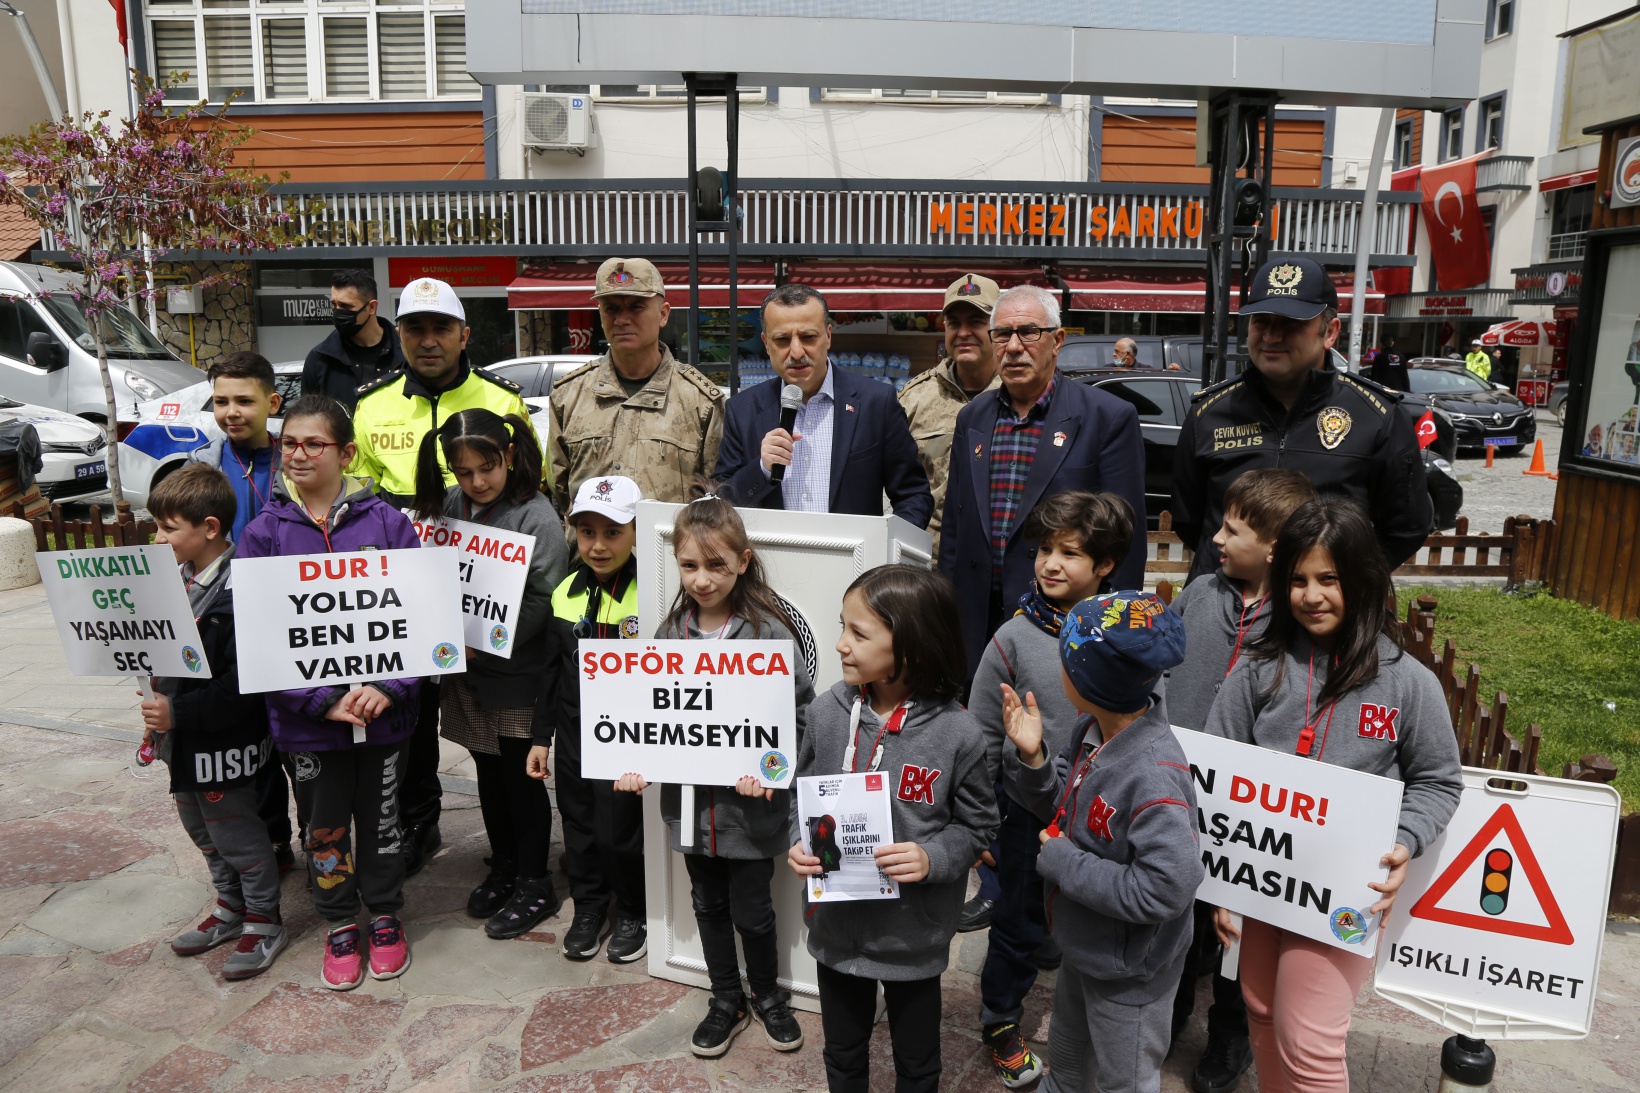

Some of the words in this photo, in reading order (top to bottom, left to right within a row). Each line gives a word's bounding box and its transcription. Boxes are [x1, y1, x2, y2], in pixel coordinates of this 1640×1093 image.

[930, 202, 1067, 236] MERKEZ
[163, 405, 177, 415] 112
[1236, 422, 1262, 437] KUVVET
[77, 468, 87, 477] 29
[89, 467, 95, 475] A
[96, 464, 105, 474] 59
[412, 522, 462, 546] OFÖR
[465, 535, 526, 565] AMCA
[57, 548, 151, 579] DİKKATLİ
[298, 557, 369, 582] DUR
[92, 588, 136, 615] GEÇ
[288, 587, 402, 615] YOLDA
[69, 619, 176, 646] YAŞAMAYI
[288, 623, 355, 649] BEN
[367, 619, 408, 642] DE
[113, 651, 153, 677] SEÇ
[295, 651, 404, 681] VARIM
[583, 645, 684, 680] ŞOFÖR
[694, 652, 789, 676] AMCA
[653, 681, 713, 710] BİZİ
[594, 714, 779, 749] ÖNEMSEYİN
[1357, 703, 1399, 741] BK
[819, 784, 826, 797] 5
[897, 763, 941, 805] BK
[1229, 775, 1329, 826] DUR!
[842, 834, 880, 846] IŞIKLARINI
[865, 846, 873, 855] ET
[1202, 850, 1332, 915] MASIN
[1389, 942, 1470, 978] IŞIKLI
[1478, 955, 1584, 999] İŞARET
